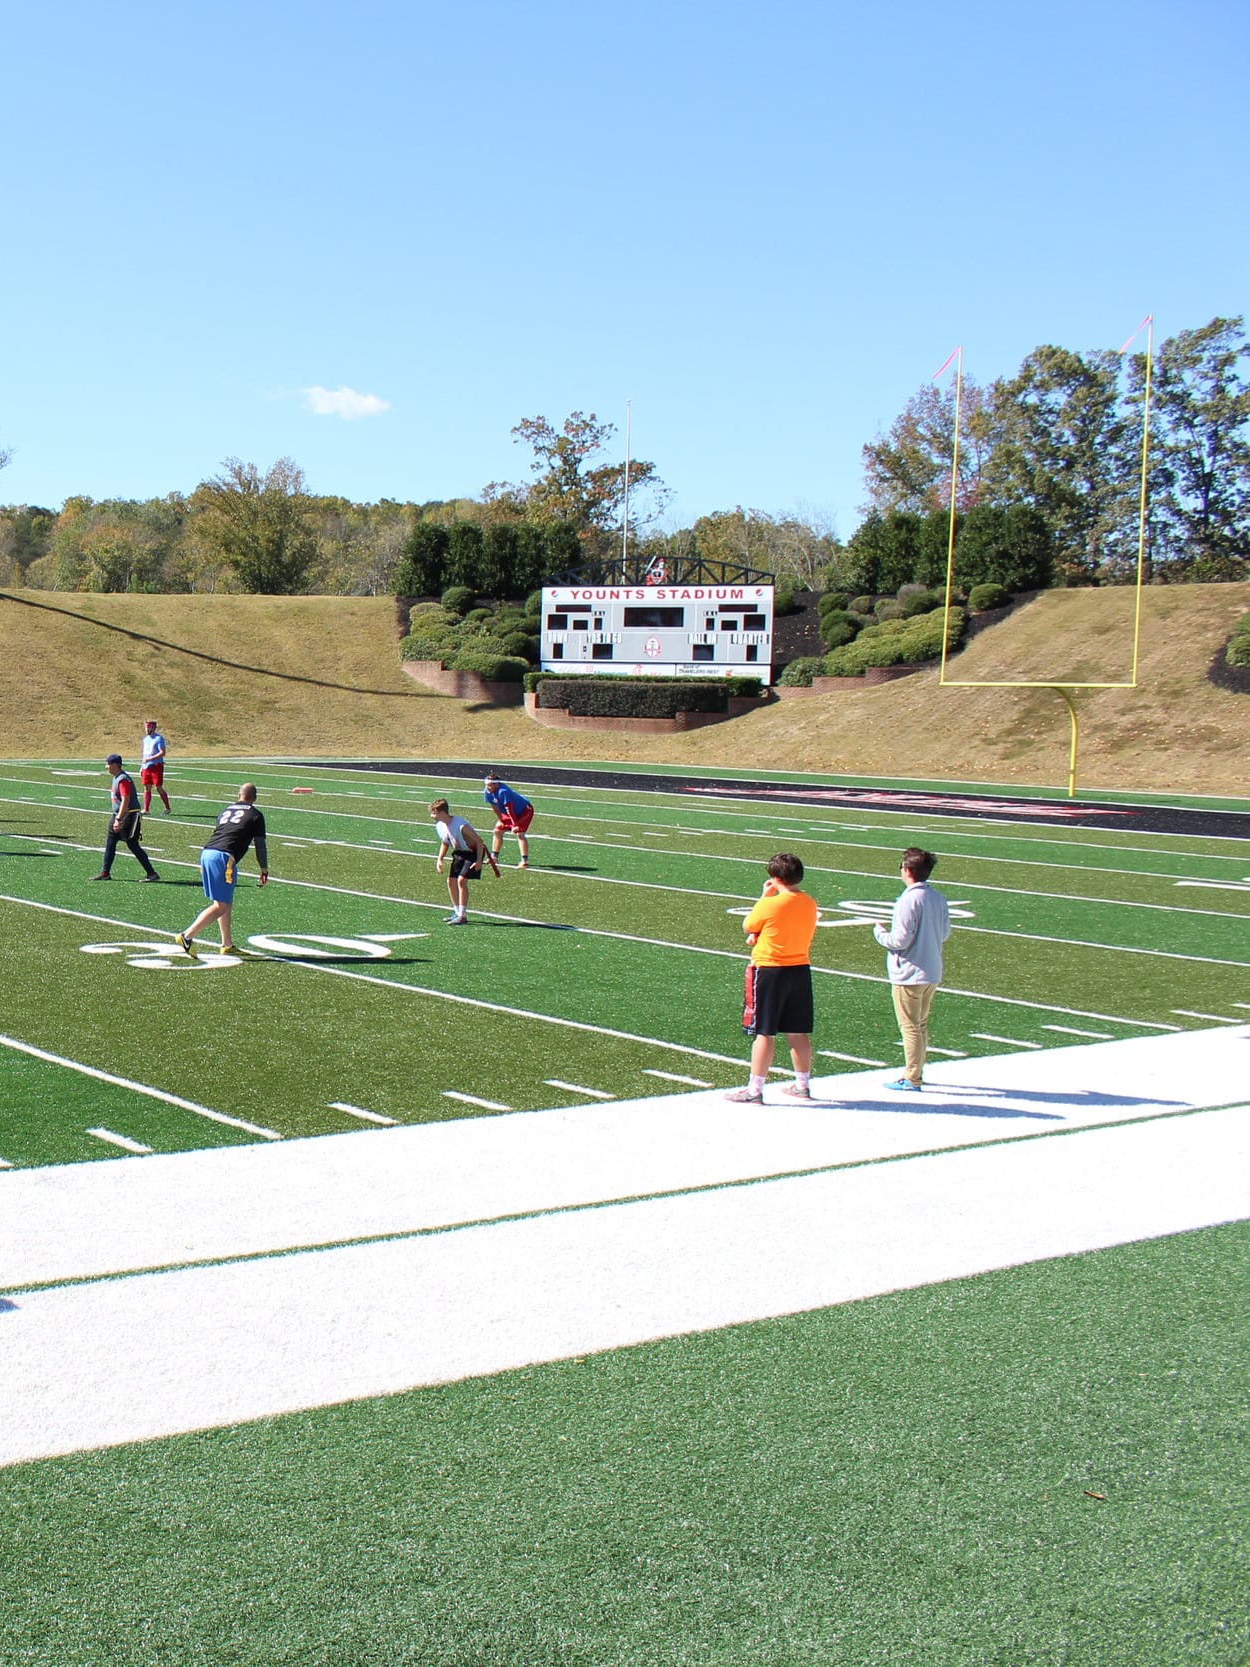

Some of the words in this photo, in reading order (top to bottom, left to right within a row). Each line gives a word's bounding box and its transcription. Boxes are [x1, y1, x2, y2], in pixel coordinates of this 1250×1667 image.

[570, 589, 645, 600] YOUNTS
[656, 588, 744, 600] STADIUM
[219, 809, 245, 824] 22
